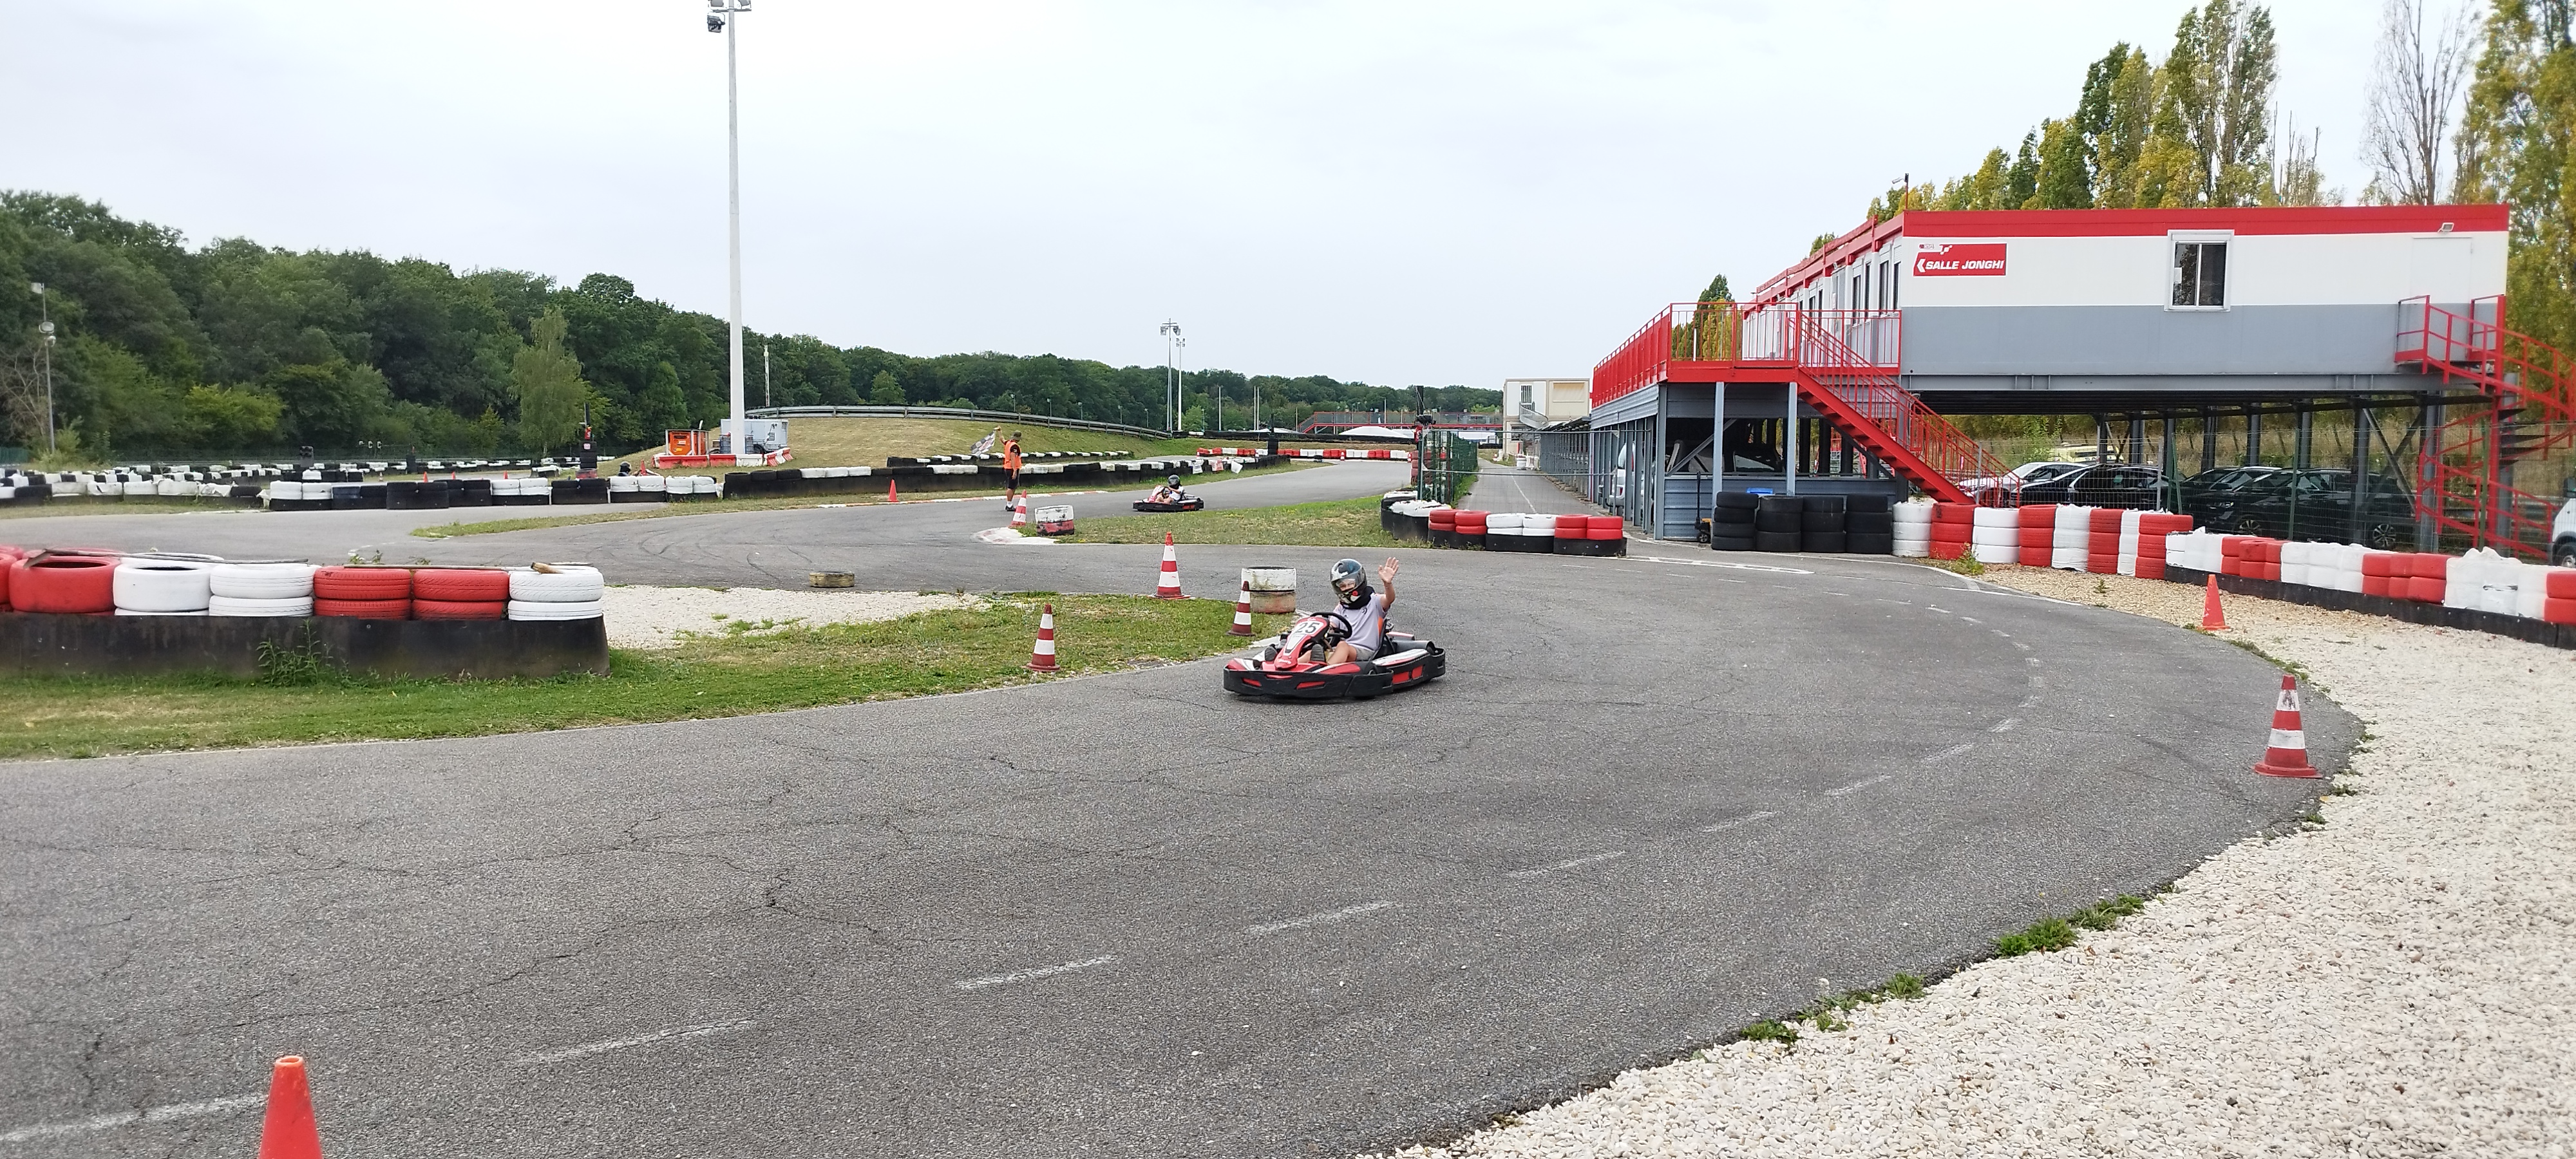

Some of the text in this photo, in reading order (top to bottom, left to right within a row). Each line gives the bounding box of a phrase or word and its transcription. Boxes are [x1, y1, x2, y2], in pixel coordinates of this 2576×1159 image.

[1926, 259, 2005, 269] SALLE JONGHI
[1295, 622, 1320, 634] 25
